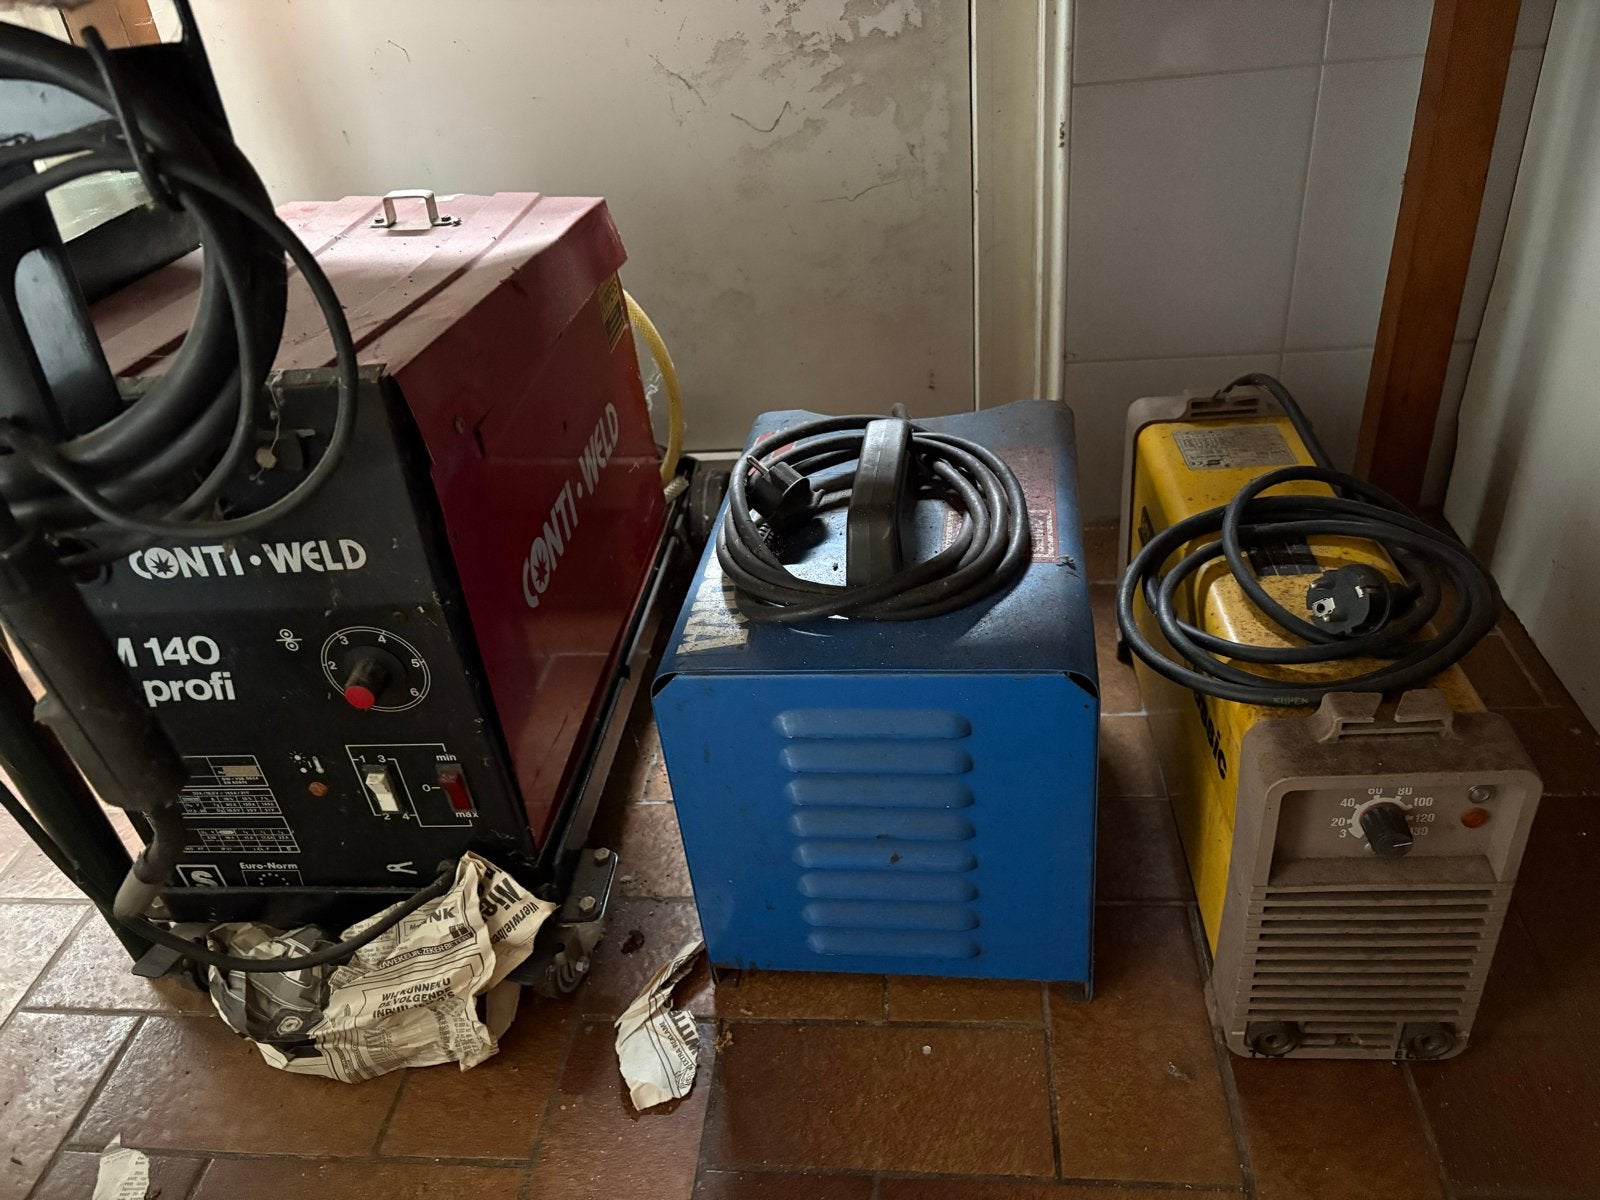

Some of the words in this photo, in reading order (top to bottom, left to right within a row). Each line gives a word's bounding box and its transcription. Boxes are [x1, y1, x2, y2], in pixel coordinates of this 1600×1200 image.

[143, 634, 221, 667] 140
[142, 671, 236, 708] profi
[435, 753, 457, 762] min
[1397, 786, 1413, 796] 80
[1340, 797, 1355, 807] 40
[1413, 796, 1434, 807] 100
[455, 811, 480, 819] max
[1415, 813, 1435, 823] 120
[1330, 817, 1346, 827] 20
[238, 861, 298, 871] Euro-Norm
